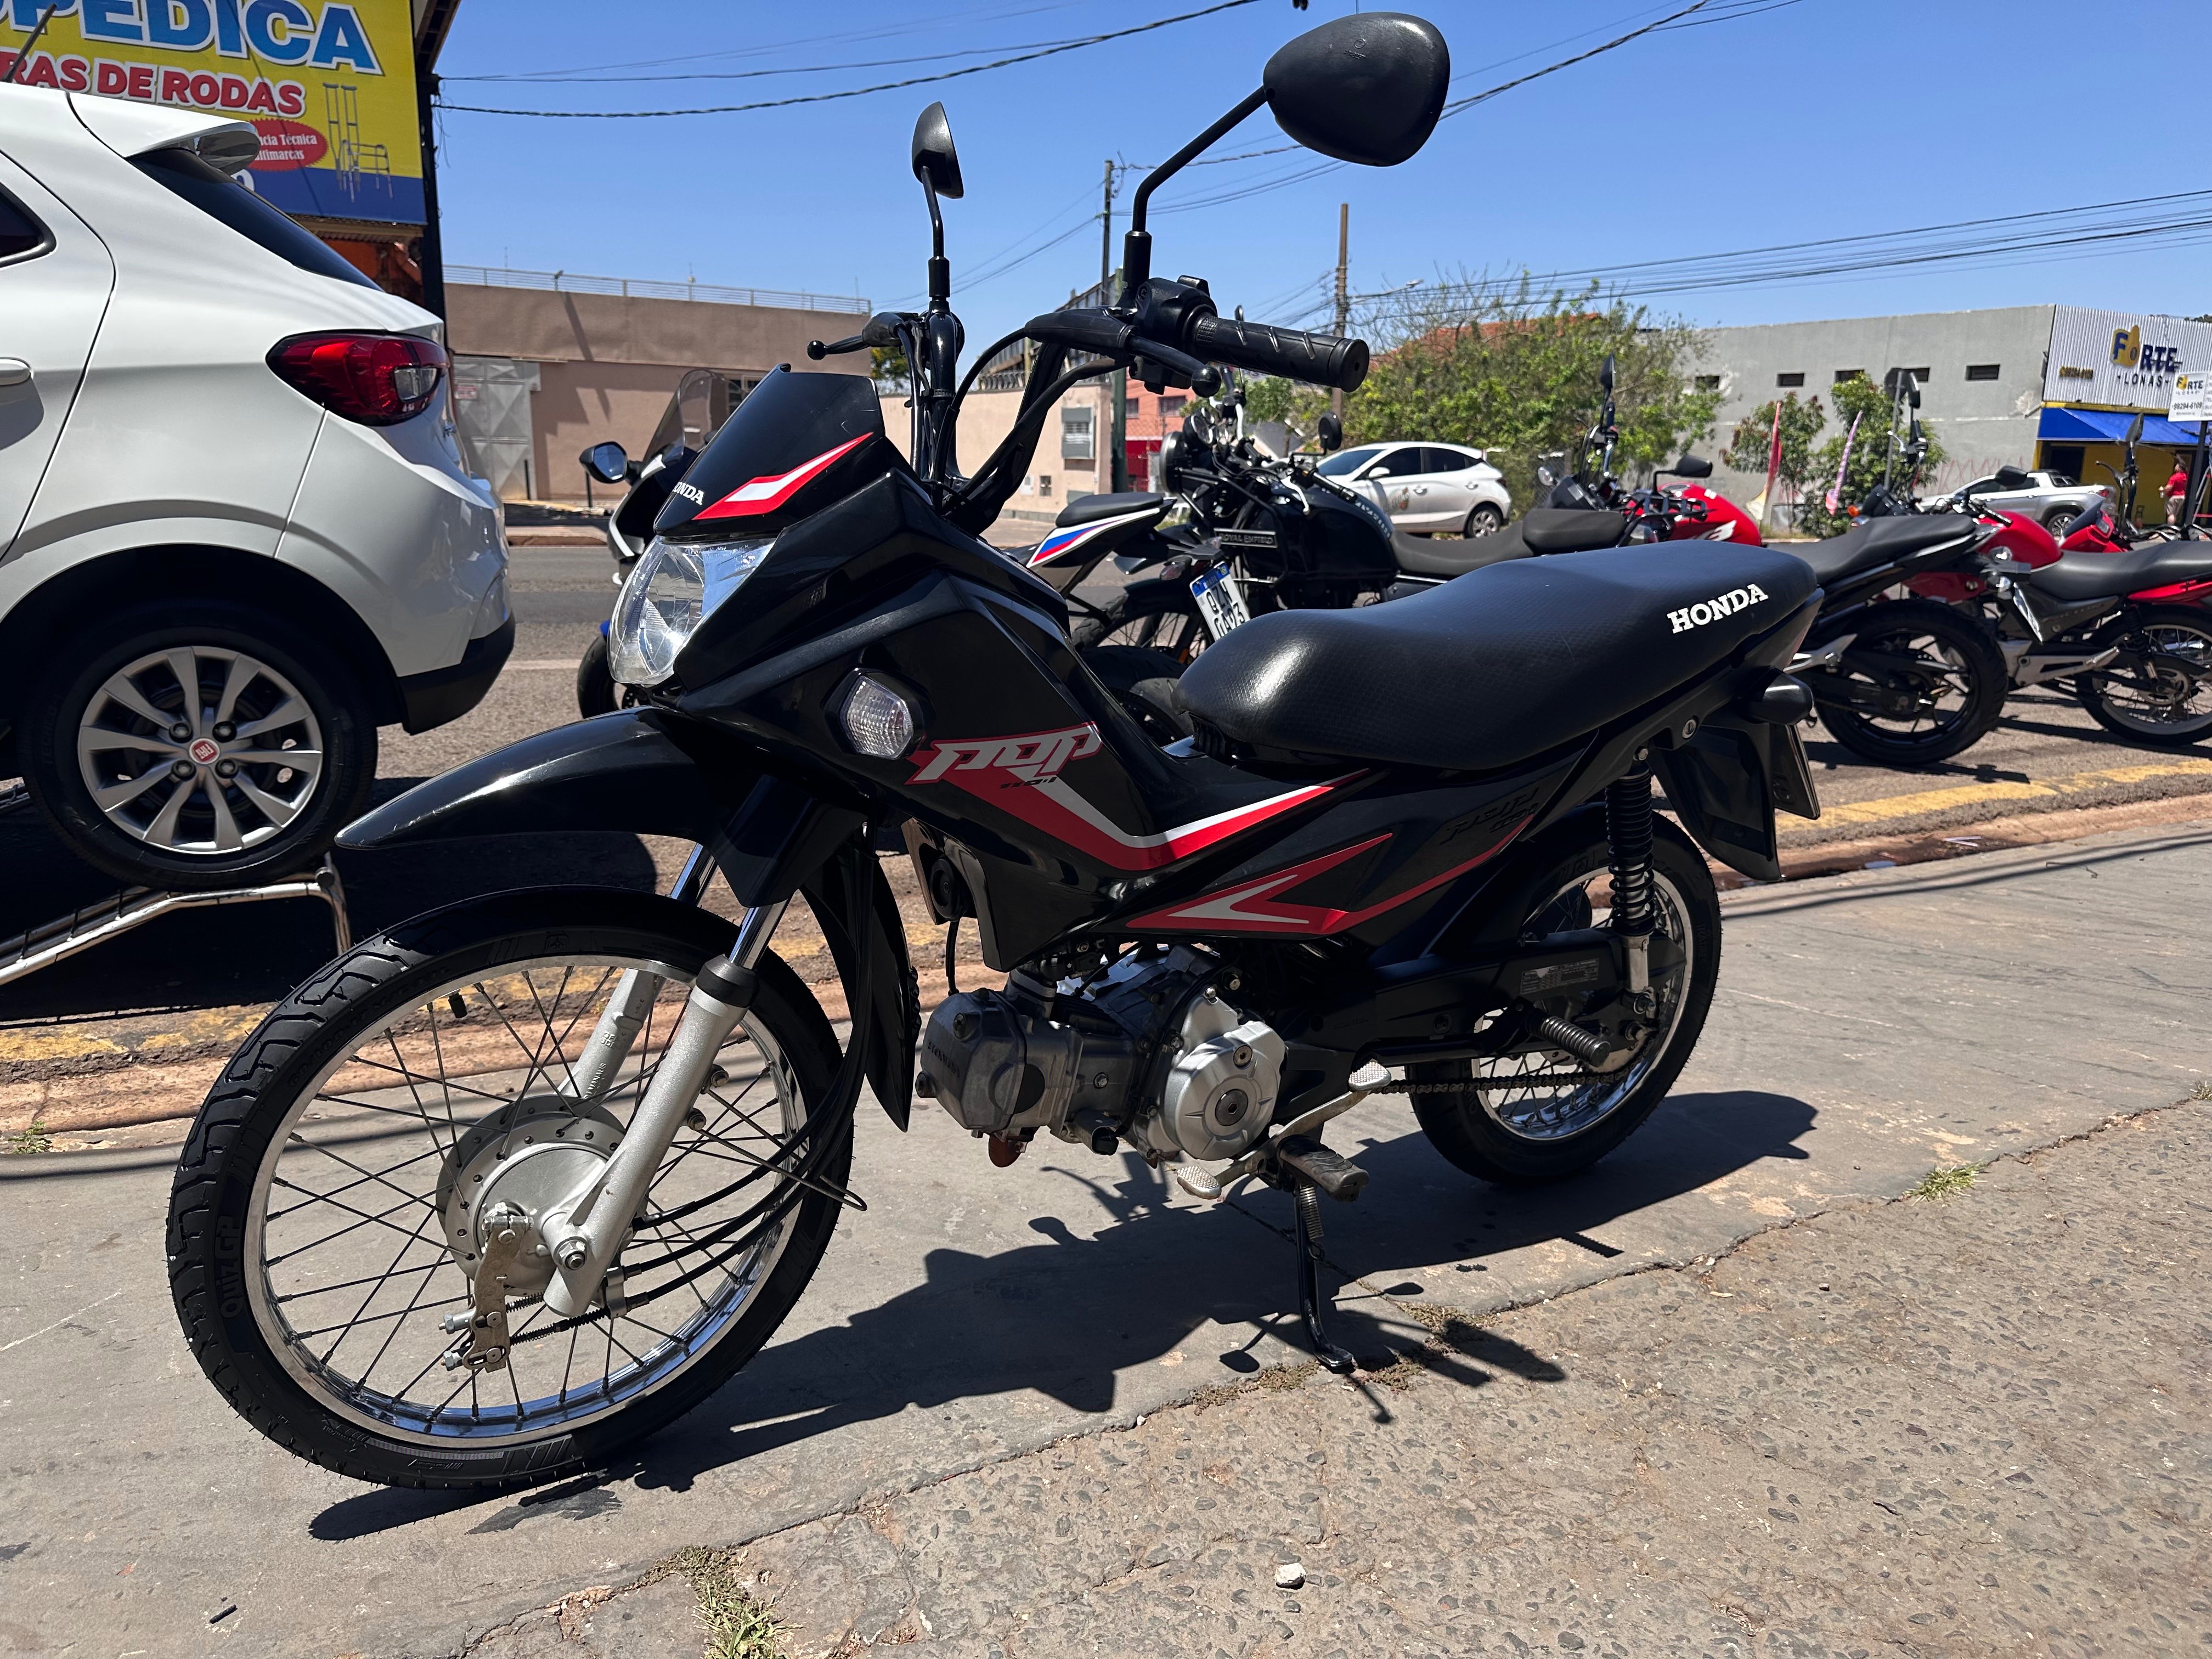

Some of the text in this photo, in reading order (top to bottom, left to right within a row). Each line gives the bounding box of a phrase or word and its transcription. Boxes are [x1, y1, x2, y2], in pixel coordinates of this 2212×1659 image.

[97, 63, 154, 99] DE
[162, 70, 303, 115] RODAS
[279, 133, 318, 146] Técnica
[1667, 583, 1769, 634] HONDA
